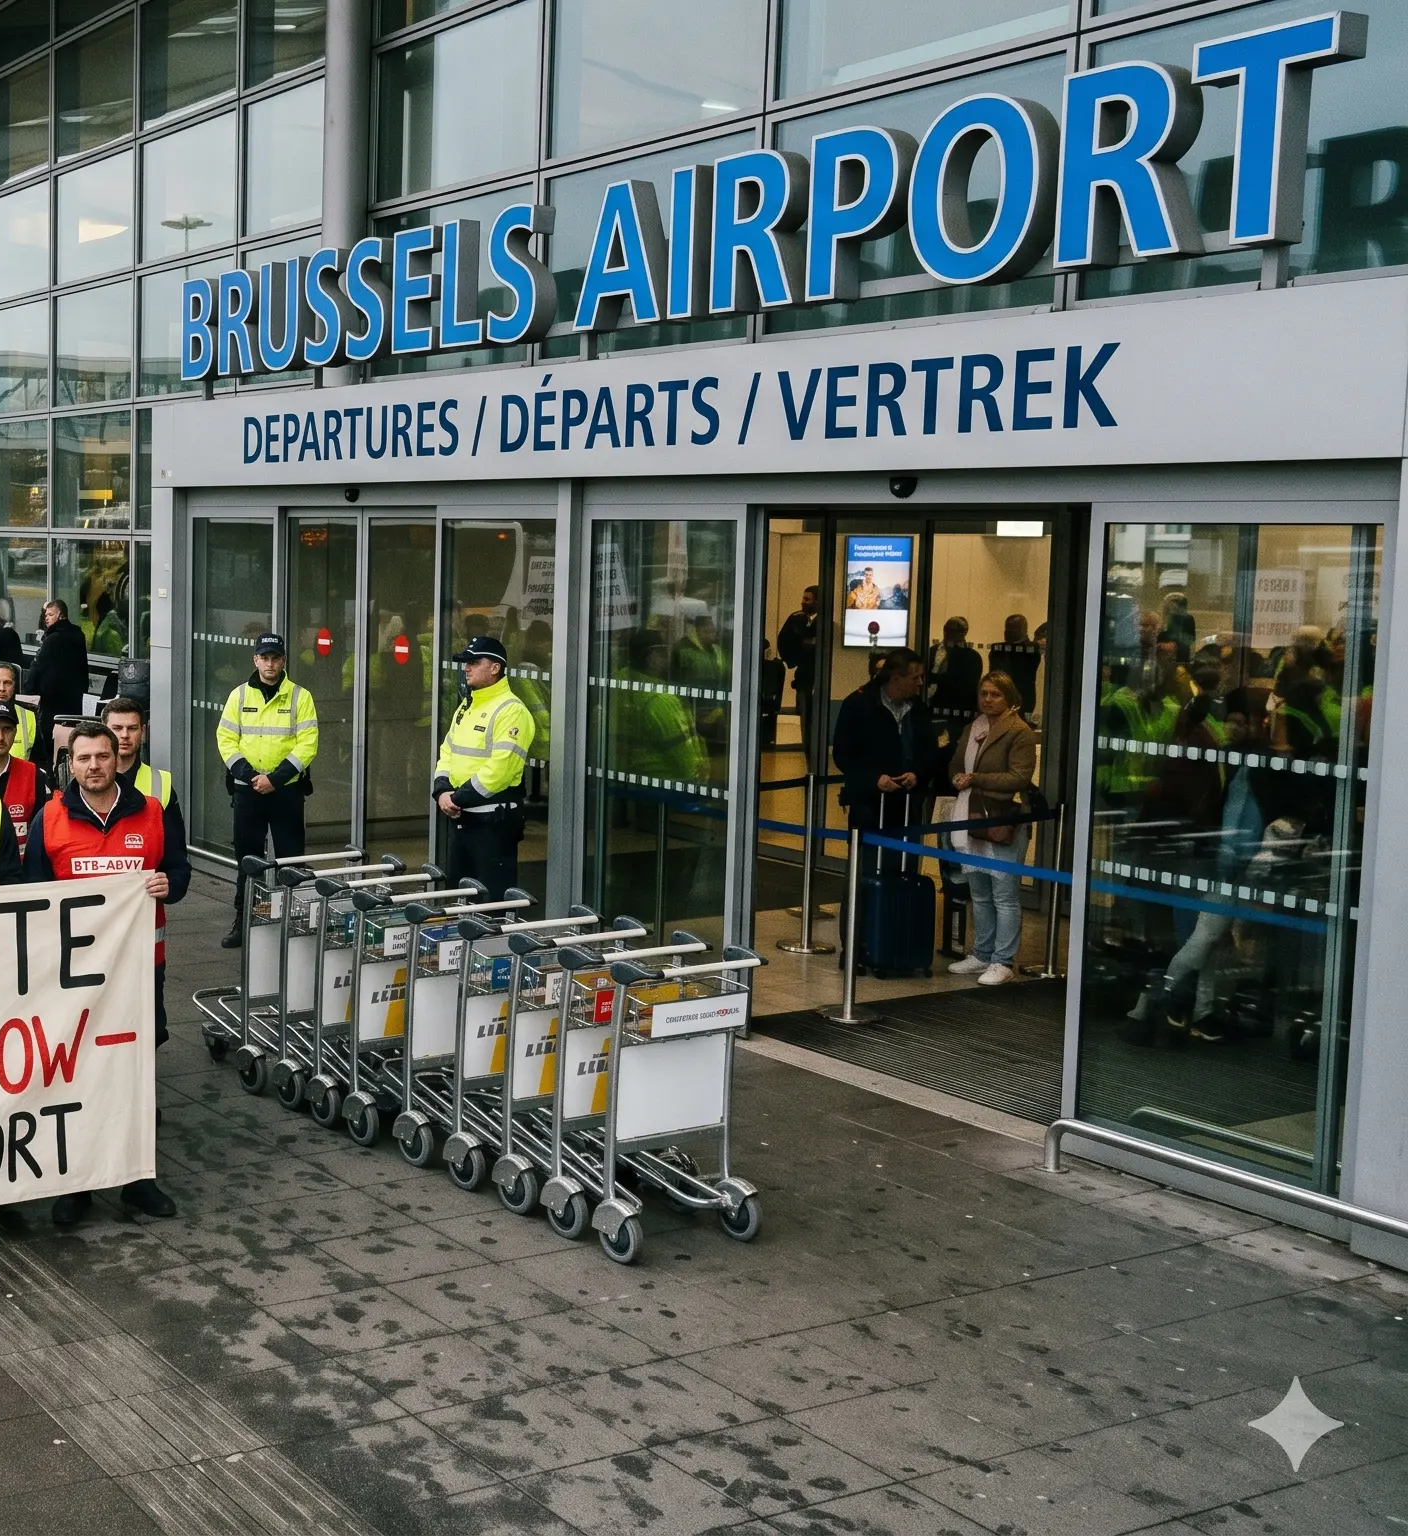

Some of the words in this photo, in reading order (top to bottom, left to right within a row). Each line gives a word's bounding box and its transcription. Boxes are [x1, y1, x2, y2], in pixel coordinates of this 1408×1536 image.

[181, 203, 538, 381] BRUSSELS
[573, 11, 1343, 331] AIRPORT
[244, 399, 458, 464] DEPARTURES
[500, 374, 719, 452] DÉPARTS
[778, 342, 1120, 440] VERTREK
